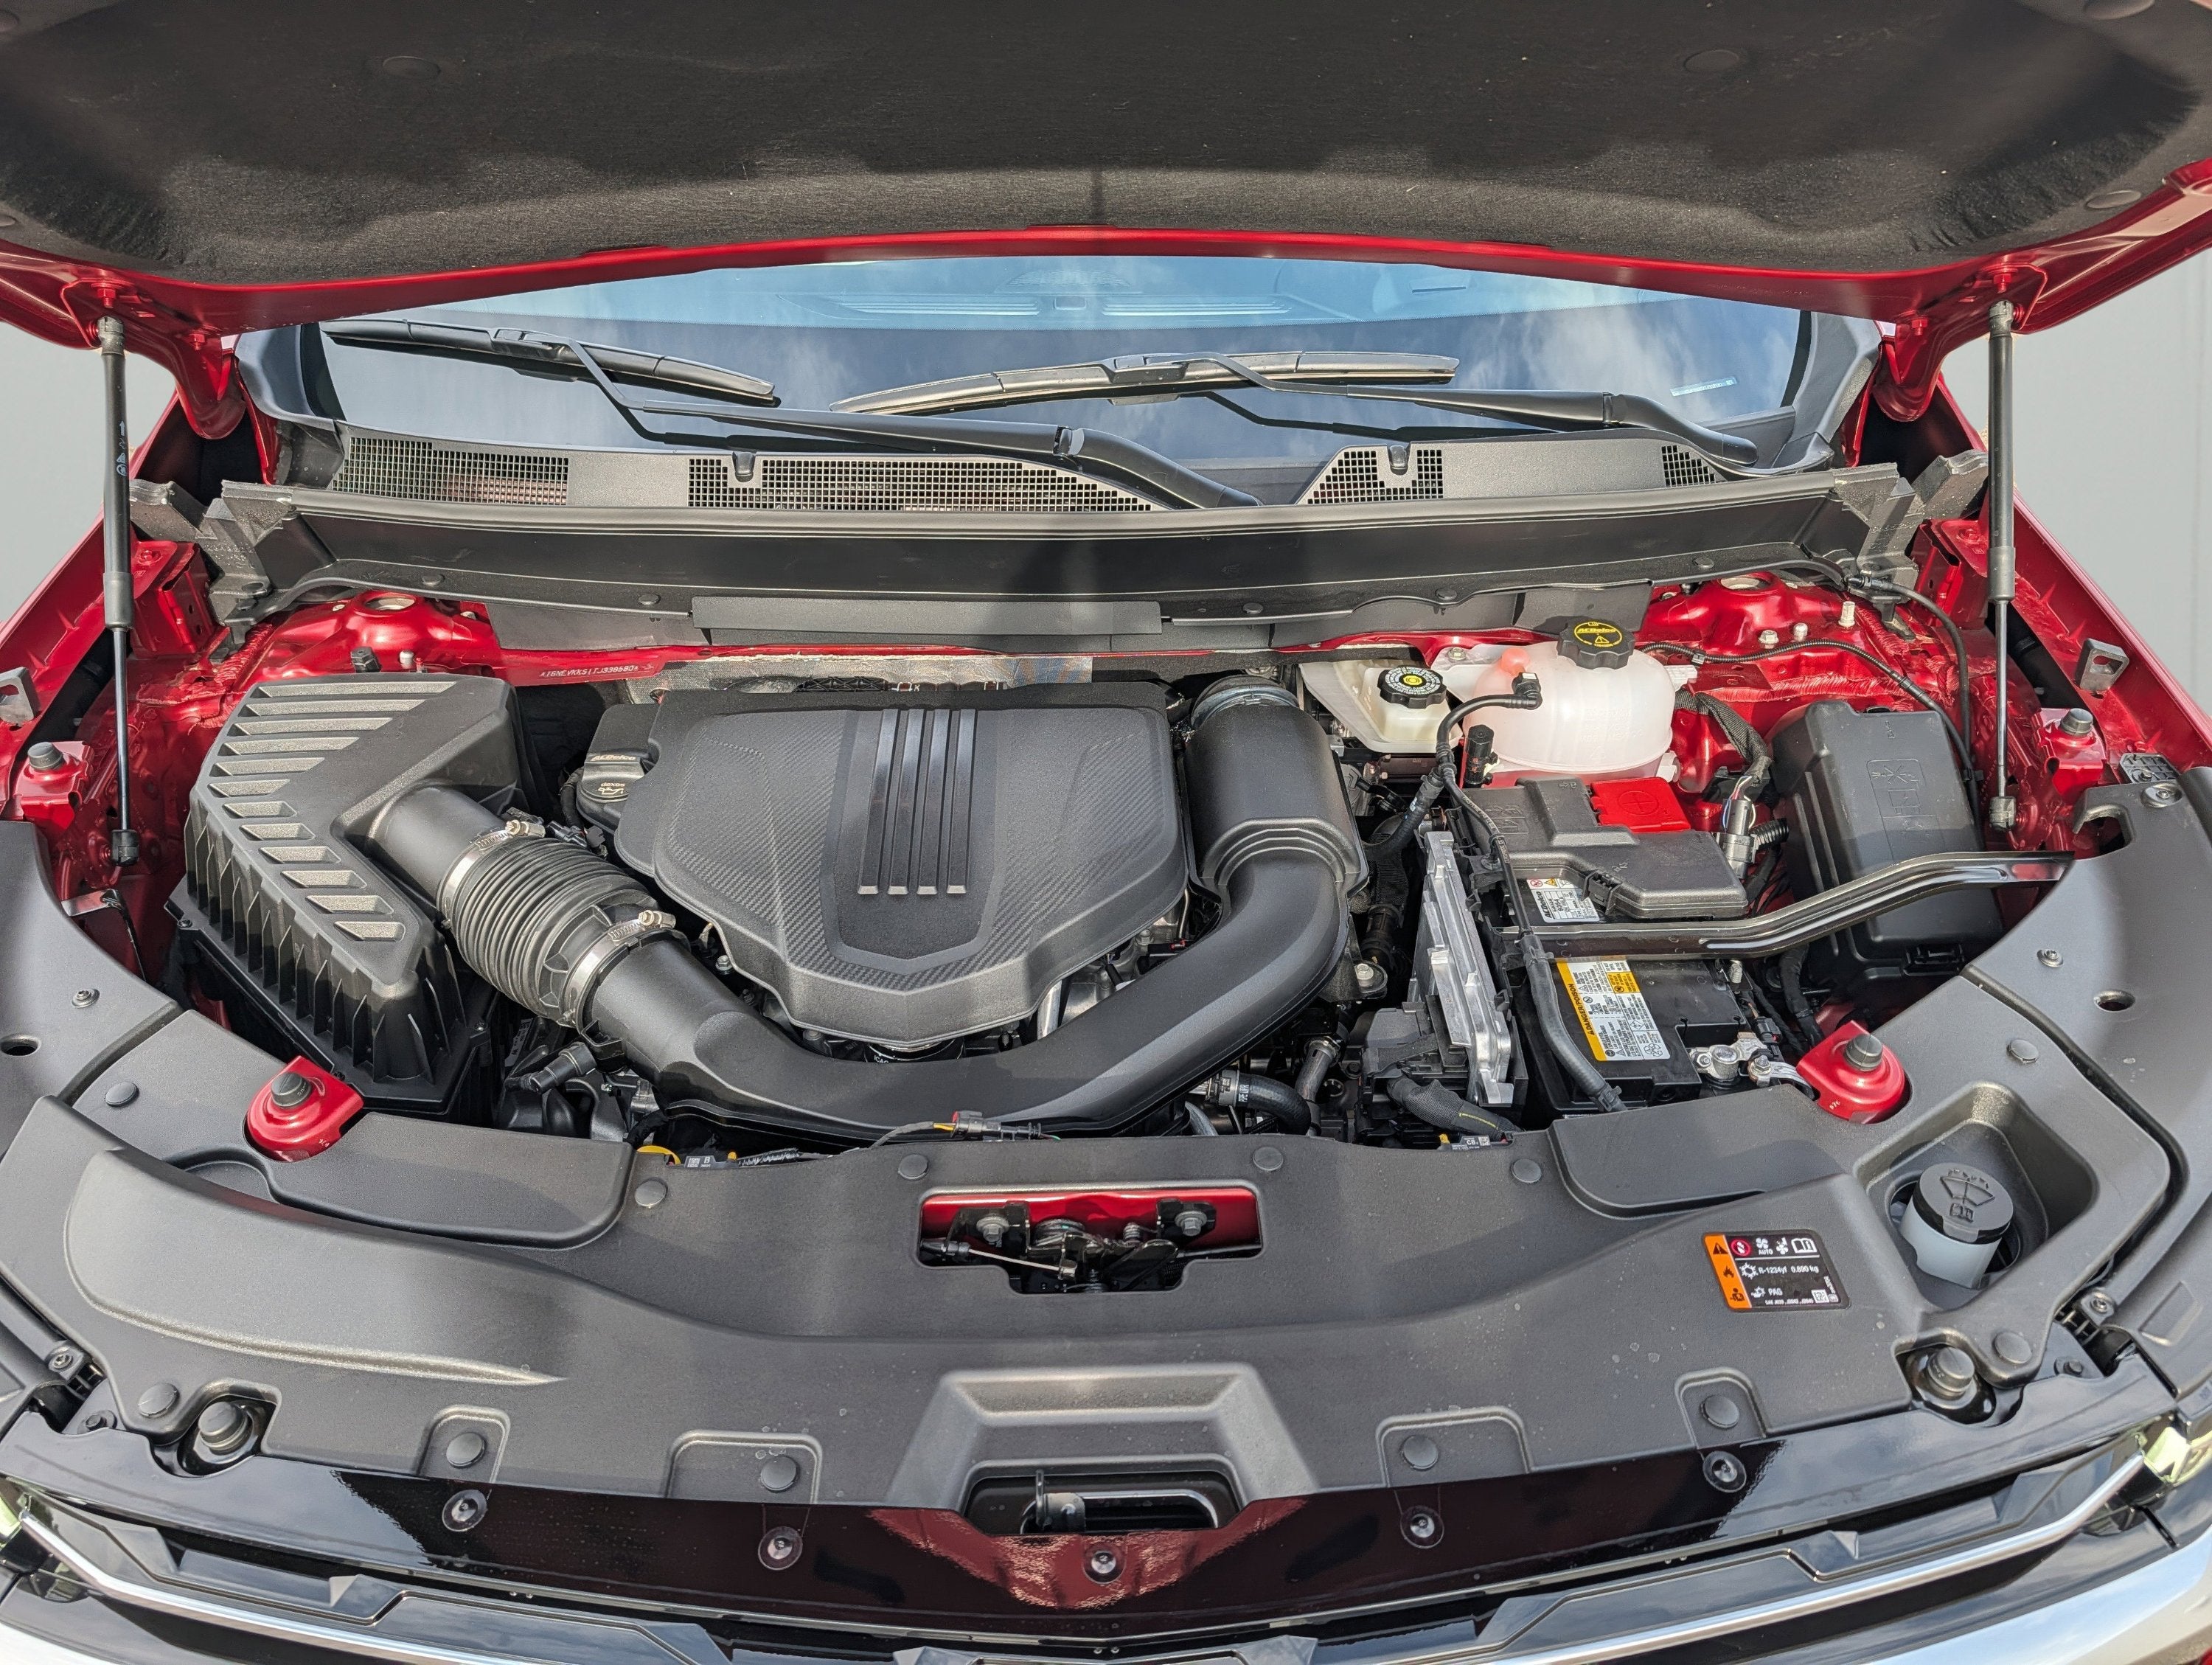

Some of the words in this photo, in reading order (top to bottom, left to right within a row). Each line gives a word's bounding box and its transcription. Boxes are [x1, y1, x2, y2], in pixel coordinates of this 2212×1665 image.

[1536, 891, 1552, 919] ACDelco
[1568, 983, 1593, 1030] DANGER/POISON
[1758, 1265, 1787, 1275] R-1234yf
[1809, 1265, 1820, 1273] kg
[1768, 1287, 1783, 1296] PAG
